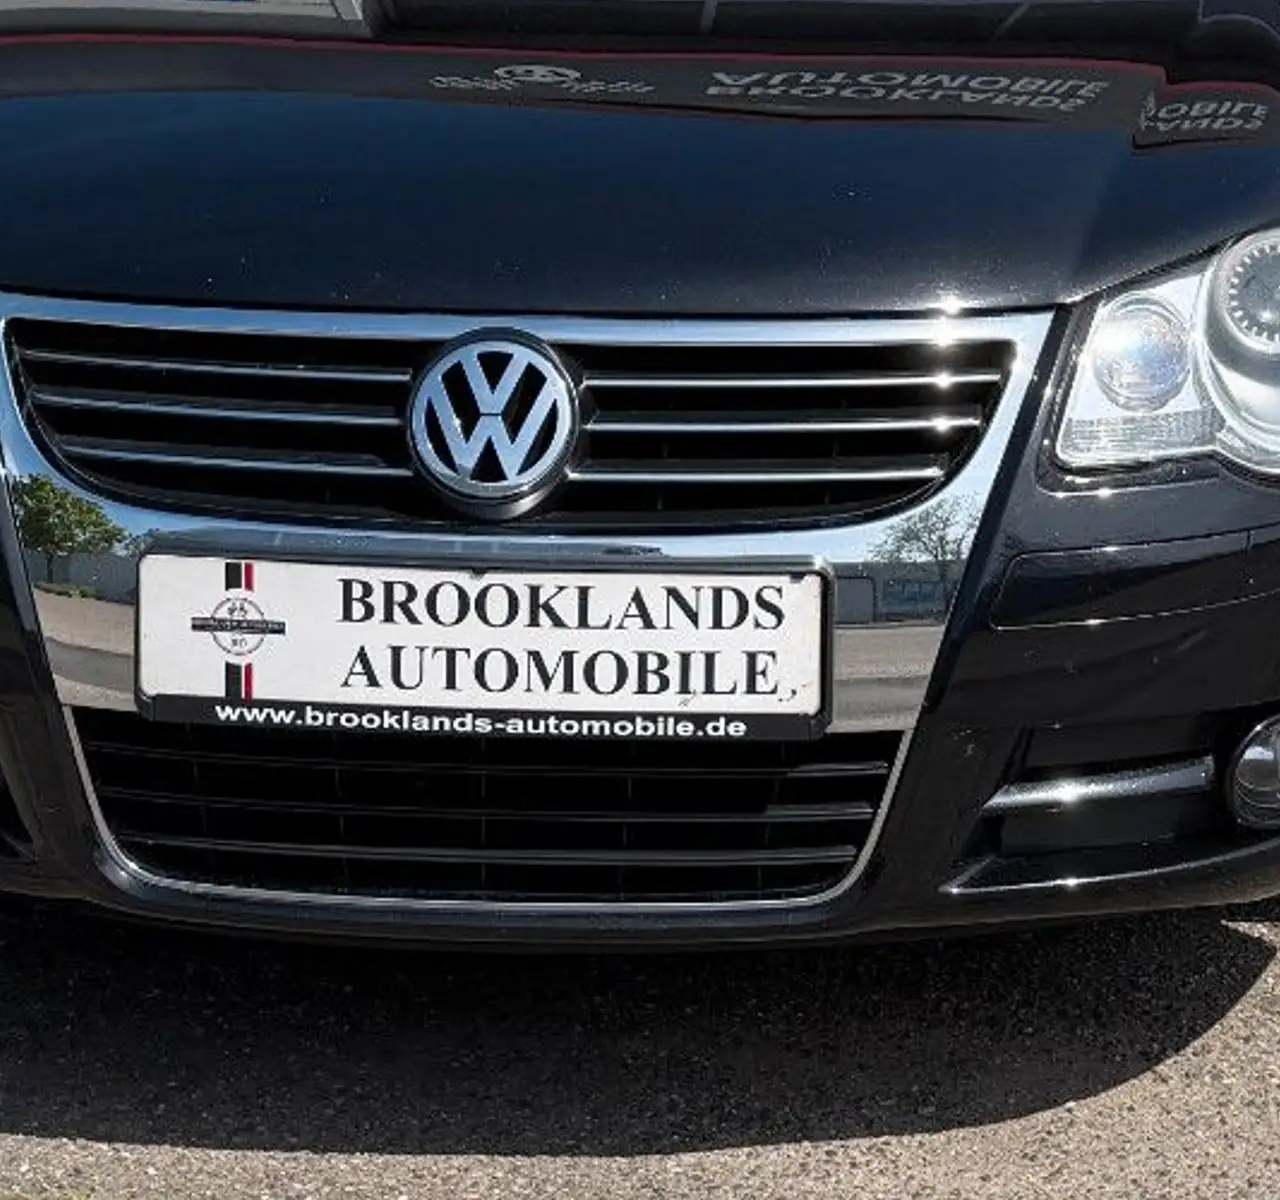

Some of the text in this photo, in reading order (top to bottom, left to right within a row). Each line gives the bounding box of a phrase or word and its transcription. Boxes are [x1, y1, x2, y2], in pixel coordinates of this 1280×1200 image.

[413, 340, 572, 498] VW
[337, 578, 786, 631] BROOKLANDS
[340, 644, 778, 696] AUTOMOBILE
[215, 705, 747, 738] www.brooklands-automobile.de
